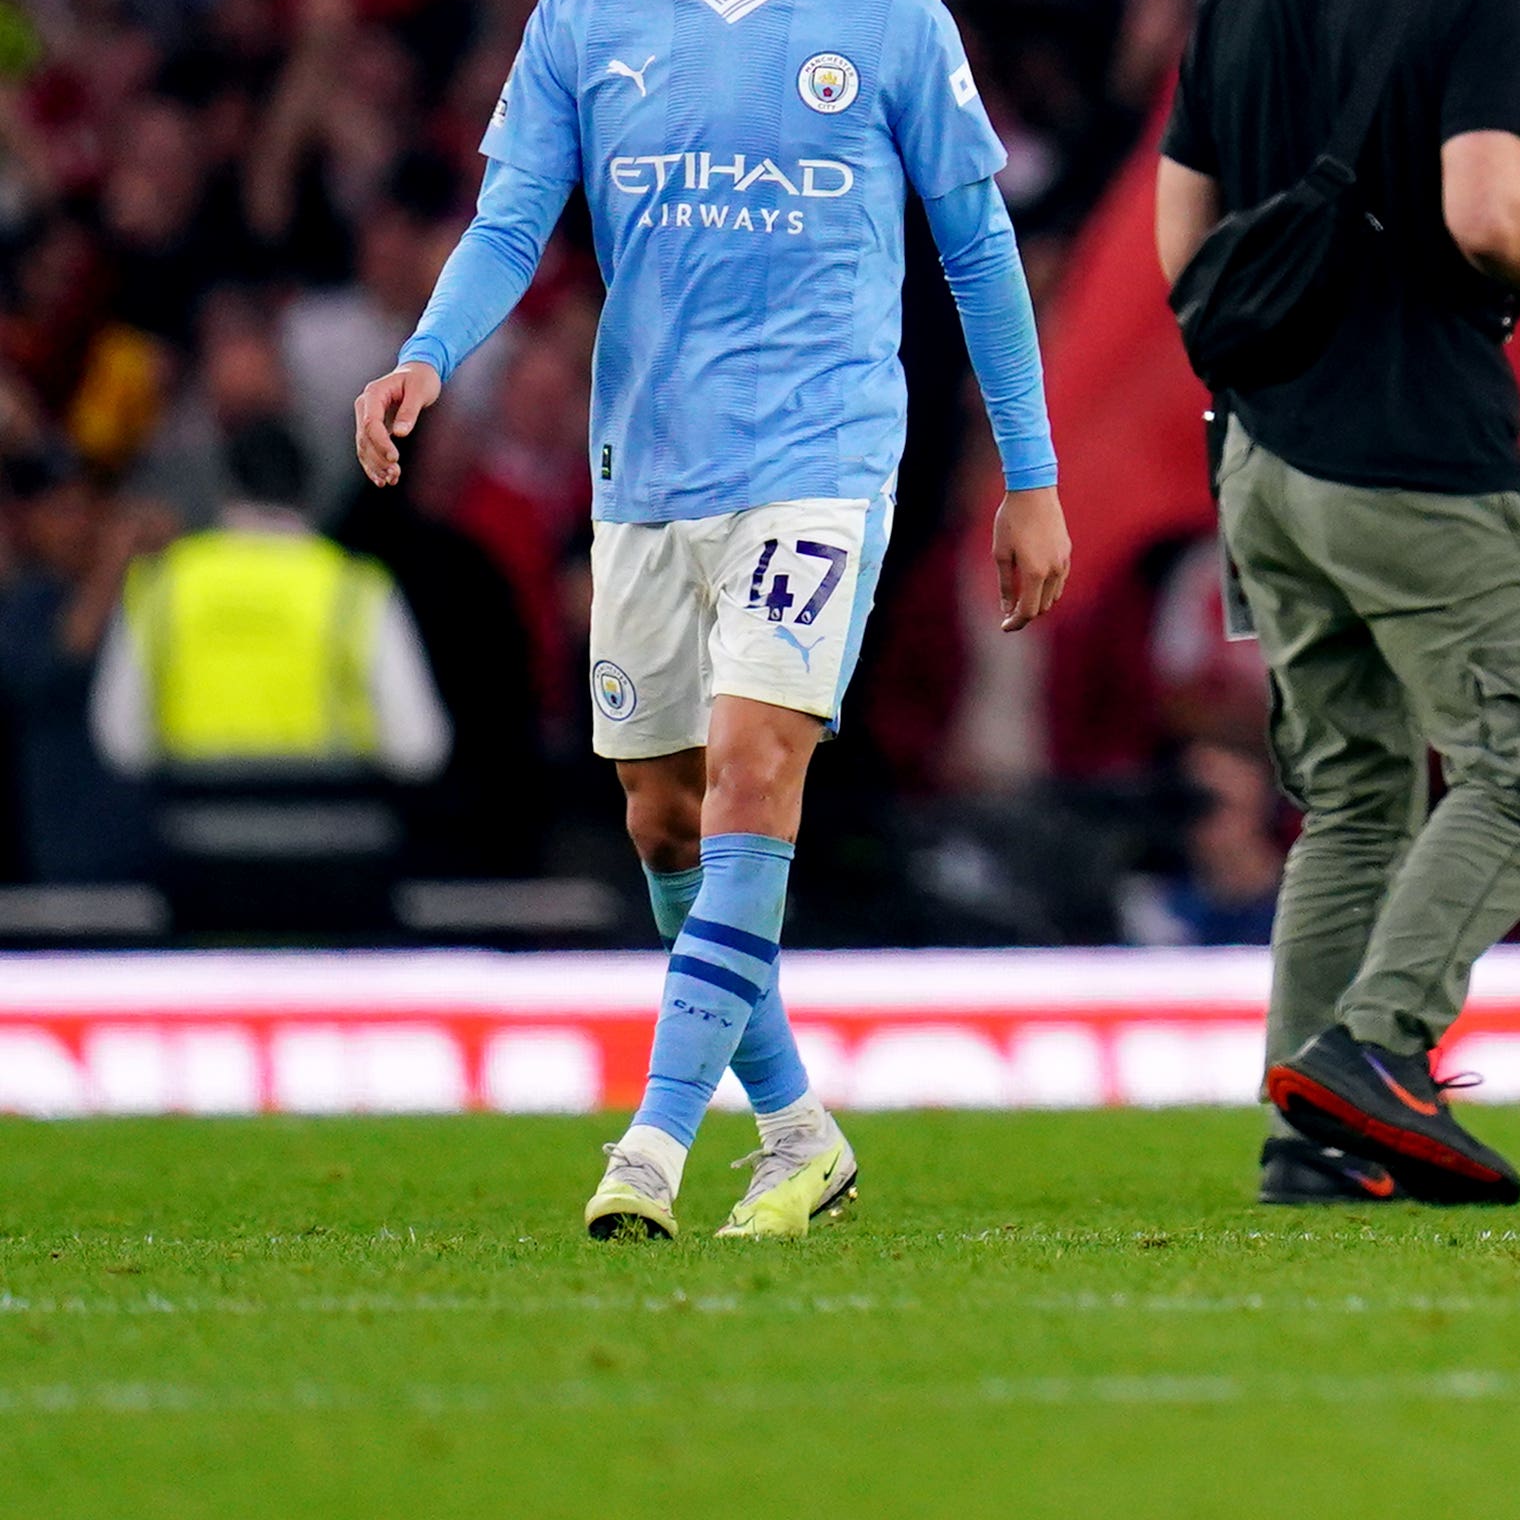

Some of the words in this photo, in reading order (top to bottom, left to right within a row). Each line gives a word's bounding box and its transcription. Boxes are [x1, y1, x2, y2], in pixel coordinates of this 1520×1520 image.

[610, 152, 854, 198] ETIHAD
[636, 203, 805, 235] AIRWAYS
[744, 538, 848, 627] 47
[673, 998, 733, 1029] CITY
